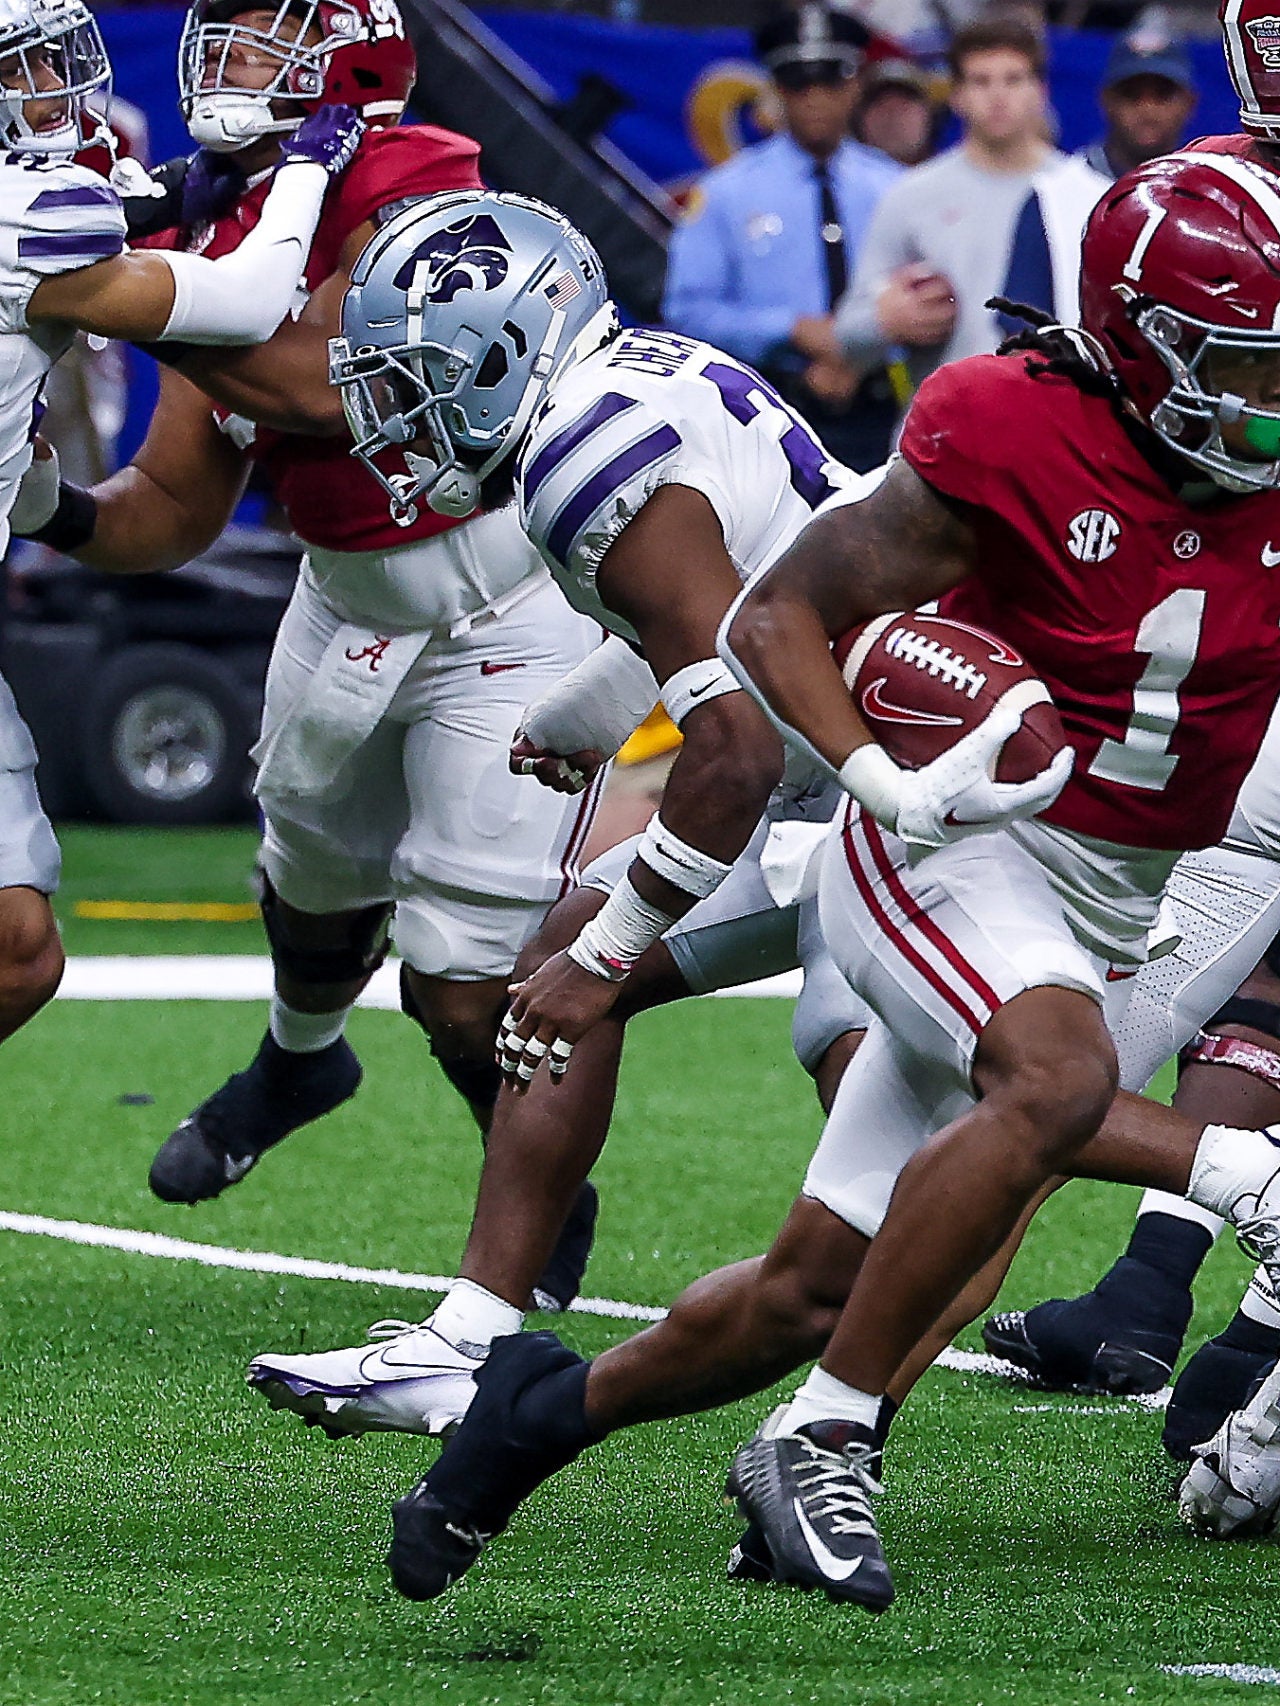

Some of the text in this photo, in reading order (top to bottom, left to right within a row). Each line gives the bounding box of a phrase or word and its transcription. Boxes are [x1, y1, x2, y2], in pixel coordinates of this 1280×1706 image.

[1122, 181, 1169, 282] 1
[1067, 510, 1121, 563] SEC
[1087, 588, 1207, 791] 1
